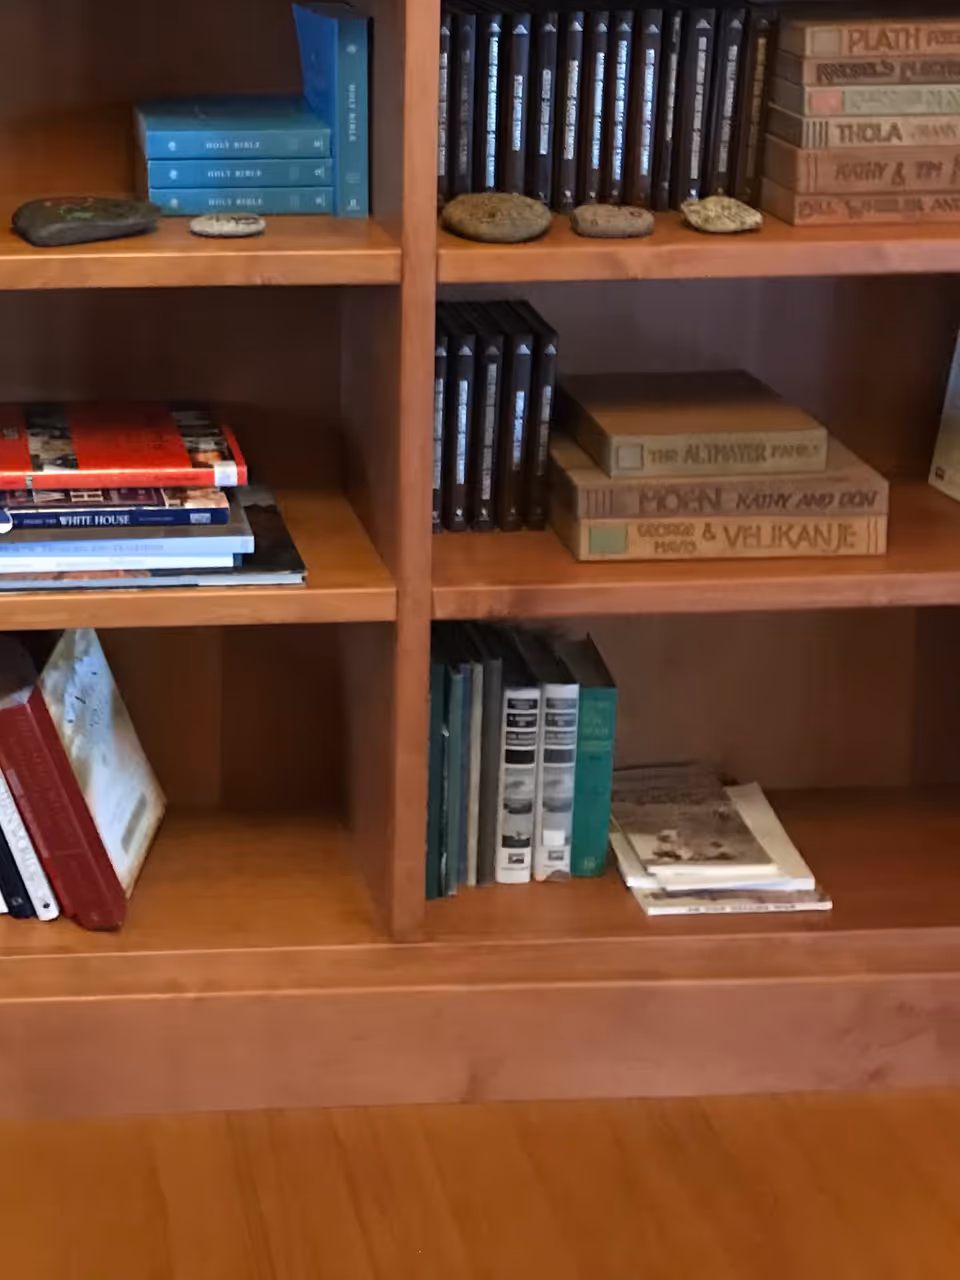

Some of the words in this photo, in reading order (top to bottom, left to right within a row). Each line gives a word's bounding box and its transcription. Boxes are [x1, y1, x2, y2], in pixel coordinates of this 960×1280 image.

[348, 83, 357, 110] HOLY
[348, 112, 357, 143] BIBLE
[205, 141, 231, 150] HOLY
[233, 140, 261, 150] BIBLE
[207, 169, 232, 178] HOLY
[235, 169, 262, 178] BIBLE
[208, 197, 233, 206] HOLY
[236, 197, 263, 206] BIBLE
[639, 488, 722, 513] MOEN
[736, 492, 790, 509] KATHY
[795, 492, 836, 508] AND
[838, 491, 879, 508] DON
[59, 515, 94, 526] WHITE
[97, 514, 131, 525] HOUSE
[723, 523, 858, 552] VELIKANJE
